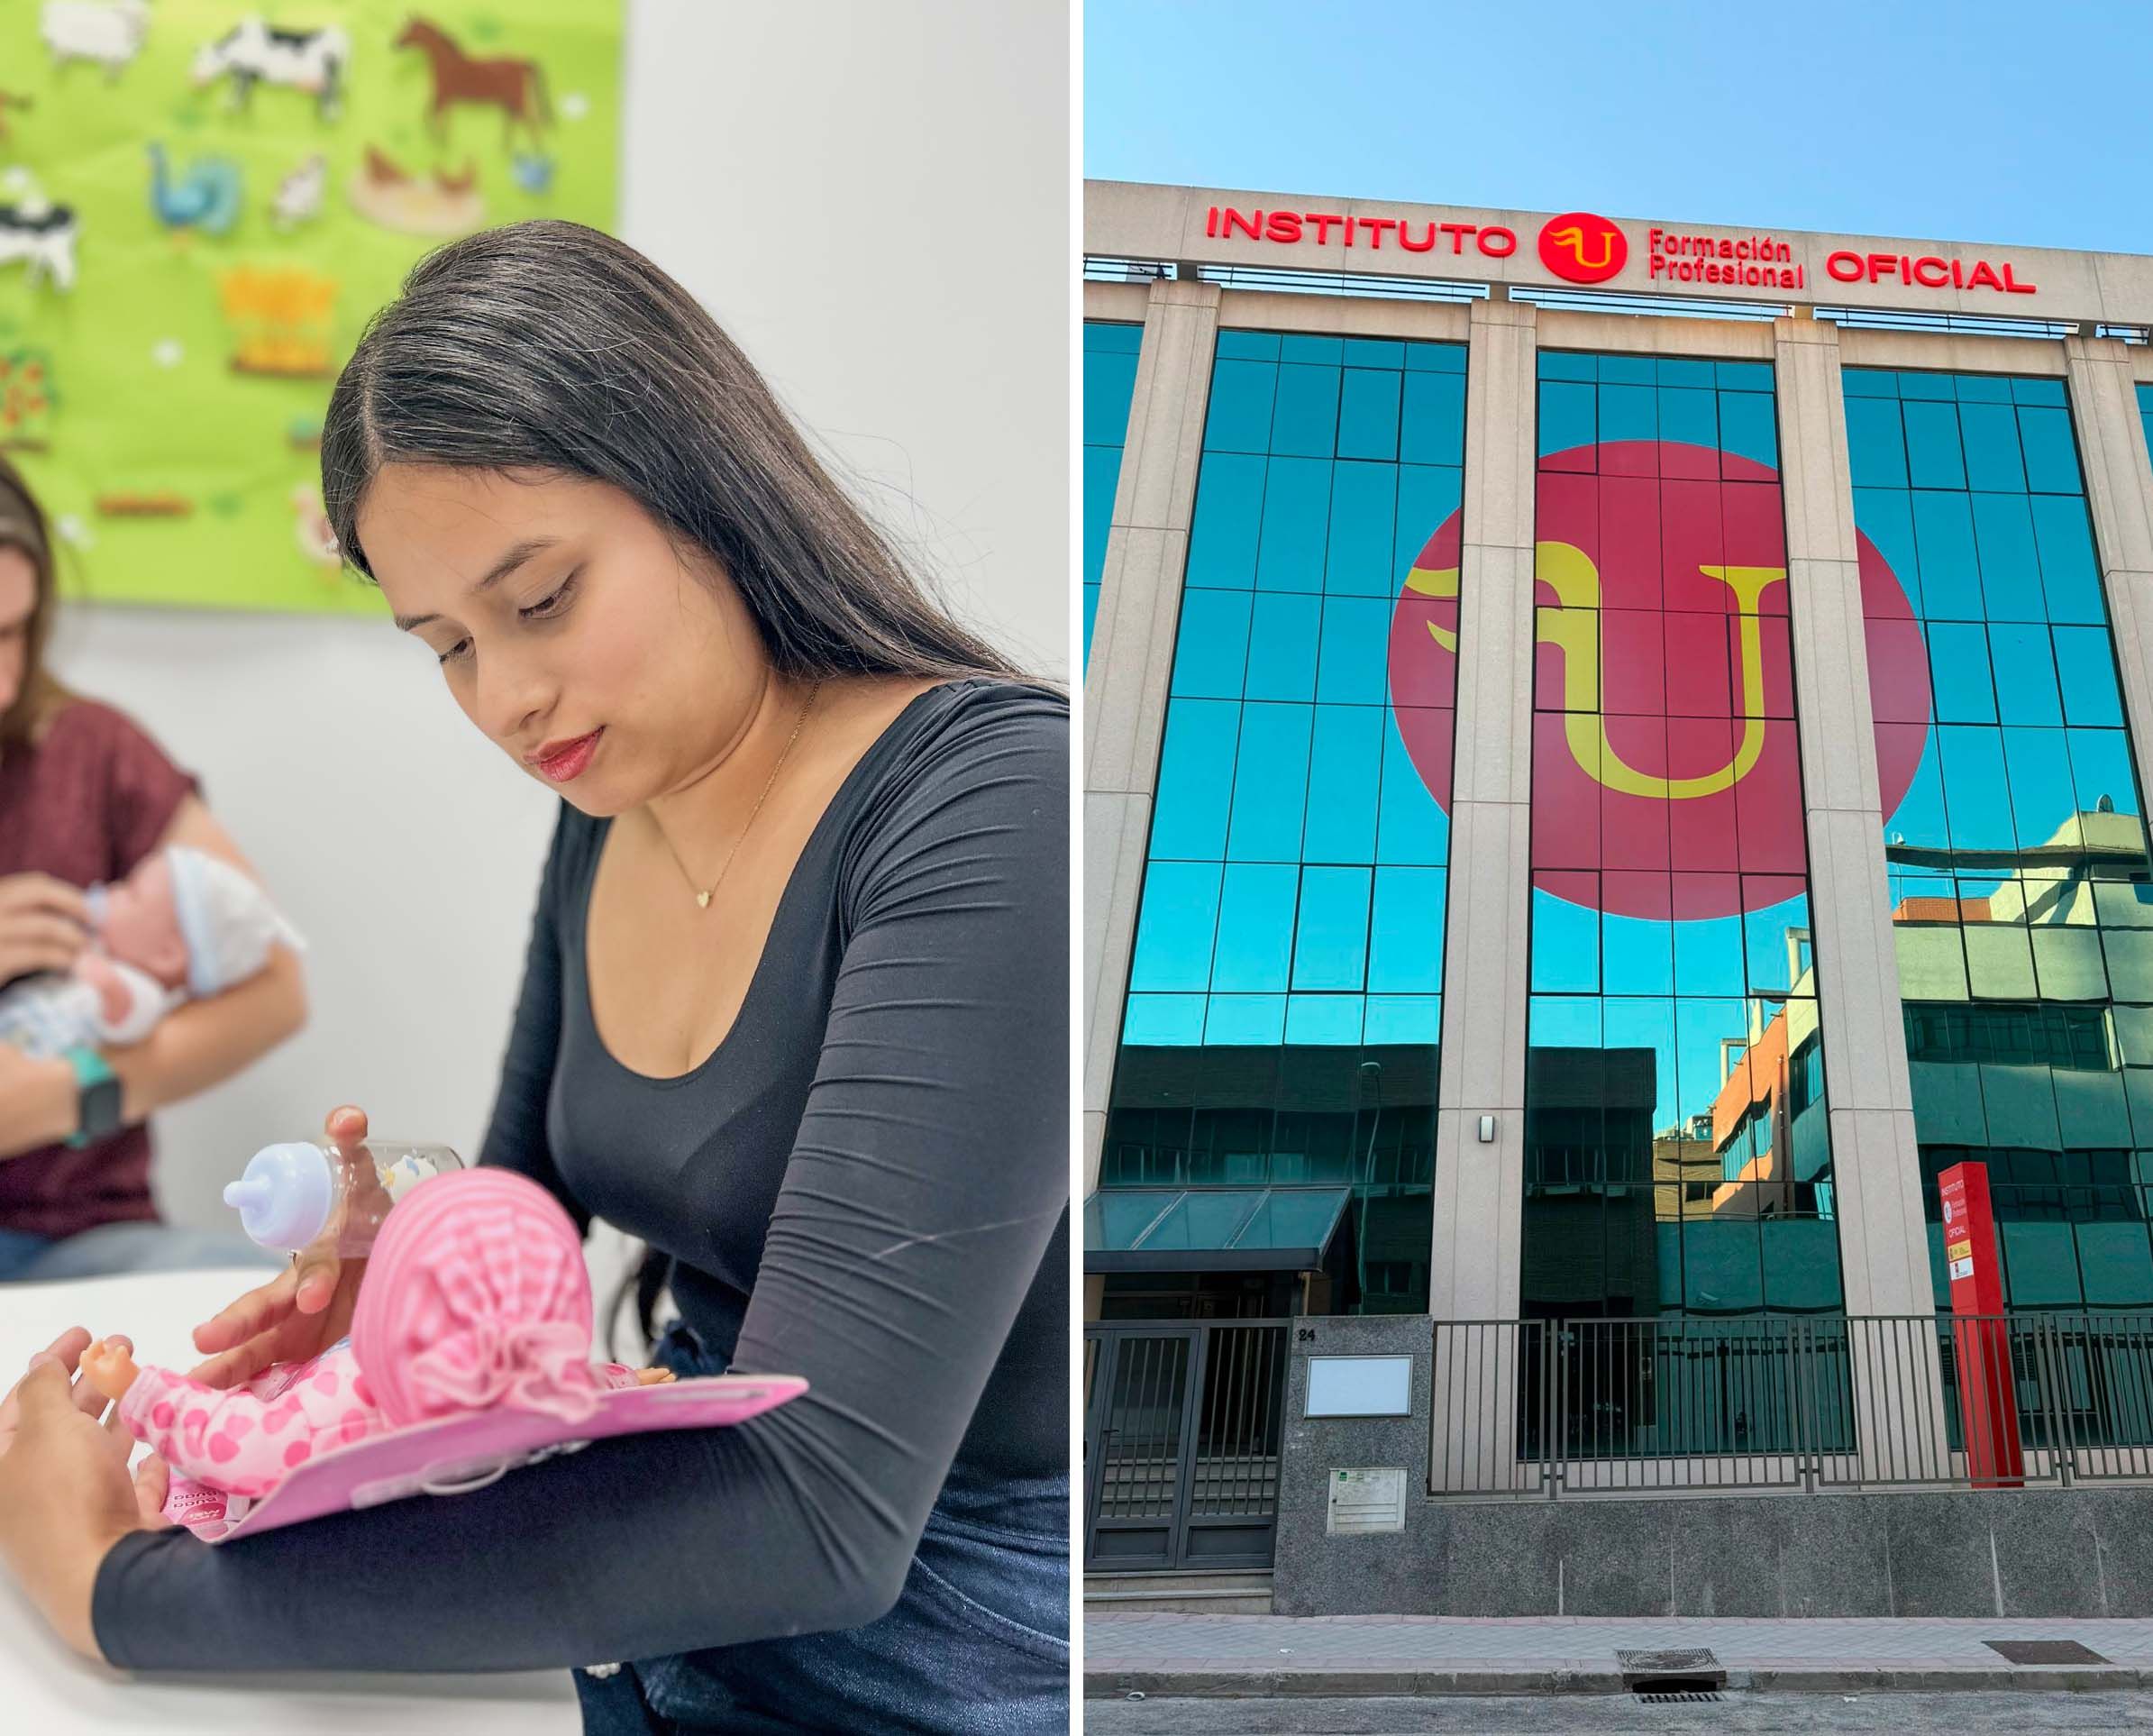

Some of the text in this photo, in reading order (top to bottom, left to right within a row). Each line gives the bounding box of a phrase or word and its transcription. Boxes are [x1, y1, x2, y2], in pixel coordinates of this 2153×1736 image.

[1205, 206, 1519, 258] INSTITUTO
[1647, 227, 1792, 263] Formación
[1648, 253, 1804, 289] Profesional
[1824, 250, 2038, 295] OFICIAL
[1298, 1329, 1316, 1341] 24
